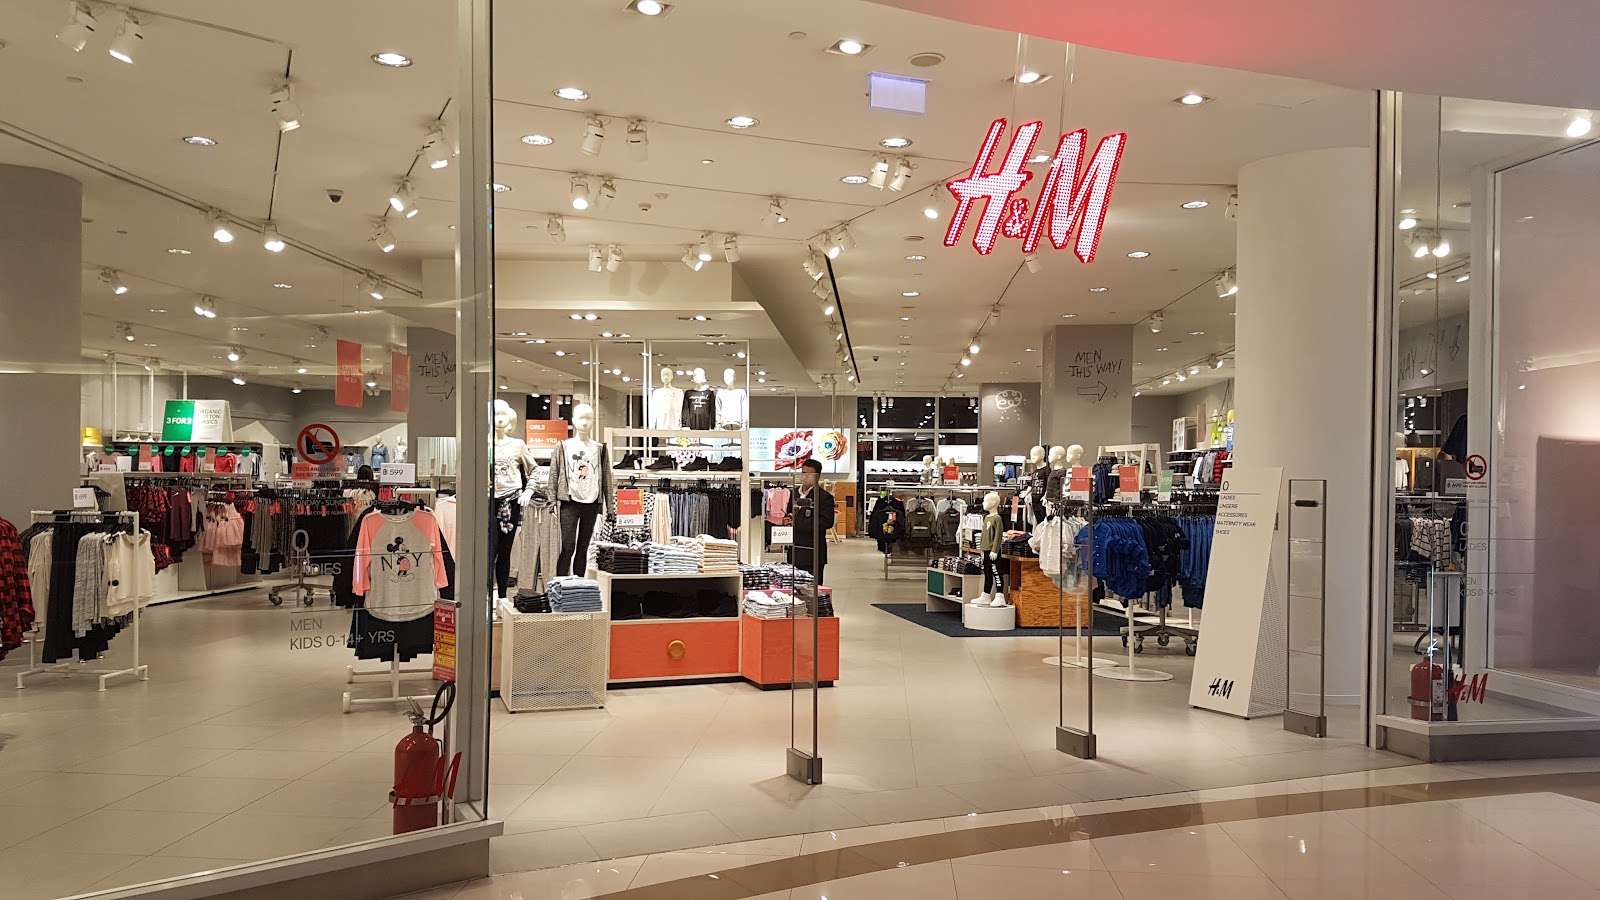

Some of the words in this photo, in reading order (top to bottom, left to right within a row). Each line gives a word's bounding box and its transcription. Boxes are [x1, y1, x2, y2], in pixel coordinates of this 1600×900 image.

[943, 117, 1127, 263] H&M
[424, 351, 448, 365] MEN
[1075, 349, 1102, 364] MEN
[419, 365, 441, 378] THIS
[442, 363, 457, 375] WA
[1069, 365, 1093, 378] THIS
[1096, 358, 1123, 375] WAY!
[389, 468, 404, 476] 599
[291, 562, 342, 578] LDIES
[290, 618, 323, 632] MEN
[290, 636, 322, 650] KIDS
[326, 633, 364, 647] 0-14+
[368, 630, 395, 644] YRS
[1207, 677, 1235, 700] H&M
[1446, 672, 1489, 705] H&M
